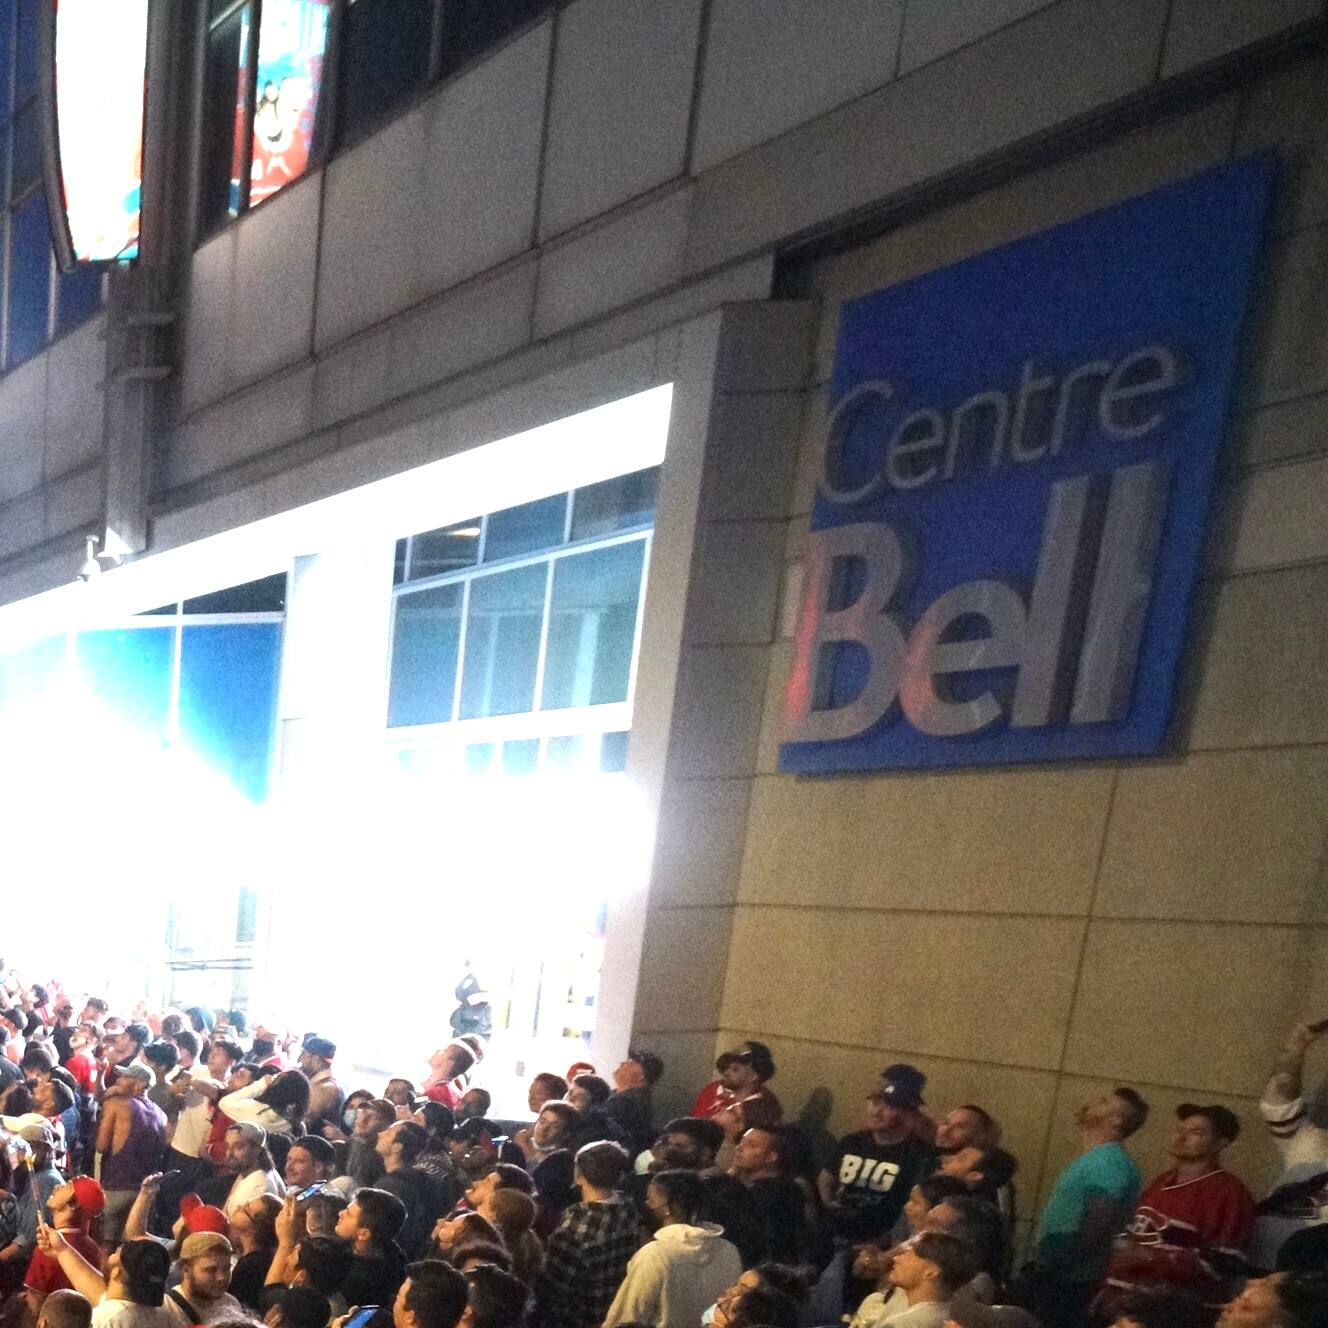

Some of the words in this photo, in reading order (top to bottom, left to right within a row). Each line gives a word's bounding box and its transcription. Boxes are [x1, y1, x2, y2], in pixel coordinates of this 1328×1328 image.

[821, 347, 1176, 501] Centre
[778, 460, 1166, 743] Bell
[840, 1153, 901, 1192] BIG
